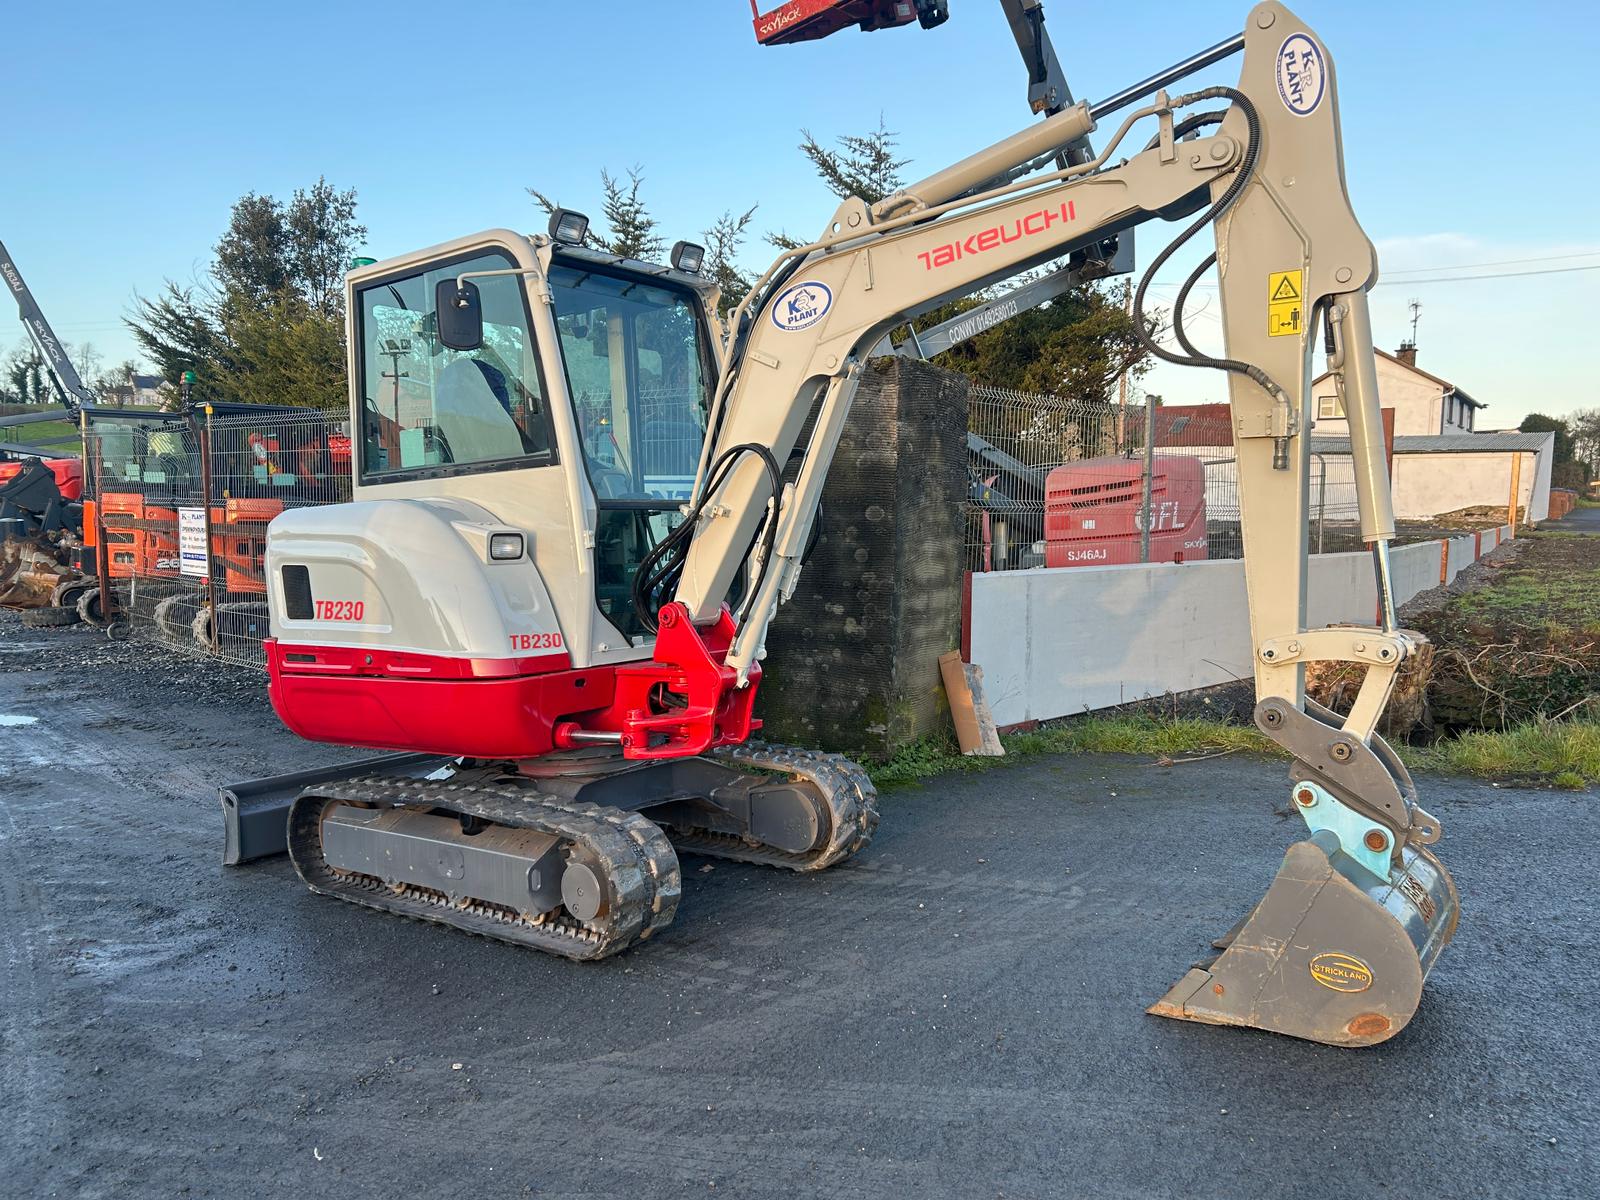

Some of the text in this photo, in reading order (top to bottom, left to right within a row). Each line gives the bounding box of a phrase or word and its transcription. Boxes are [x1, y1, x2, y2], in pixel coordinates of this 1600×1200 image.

[760, 7, 801, 35] SKYJACK
[1284, 49, 1304, 105] PLANT
[917, 200, 1077, 271] TAKEUCHI
[1, 262, 24, 292] SJ63AJ
[787, 307, 818, 325] PLANT
[949, 316, 976, 344] CONWY
[33, 319, 62, 364] SKYJACK
[1068, 549, 1107, 561] SJ46AJ
[315, 600, 364, 621] TB230
[509, 633, 562, 650] TB230
[1314, 964, 1367, 981] STRICKLAND
